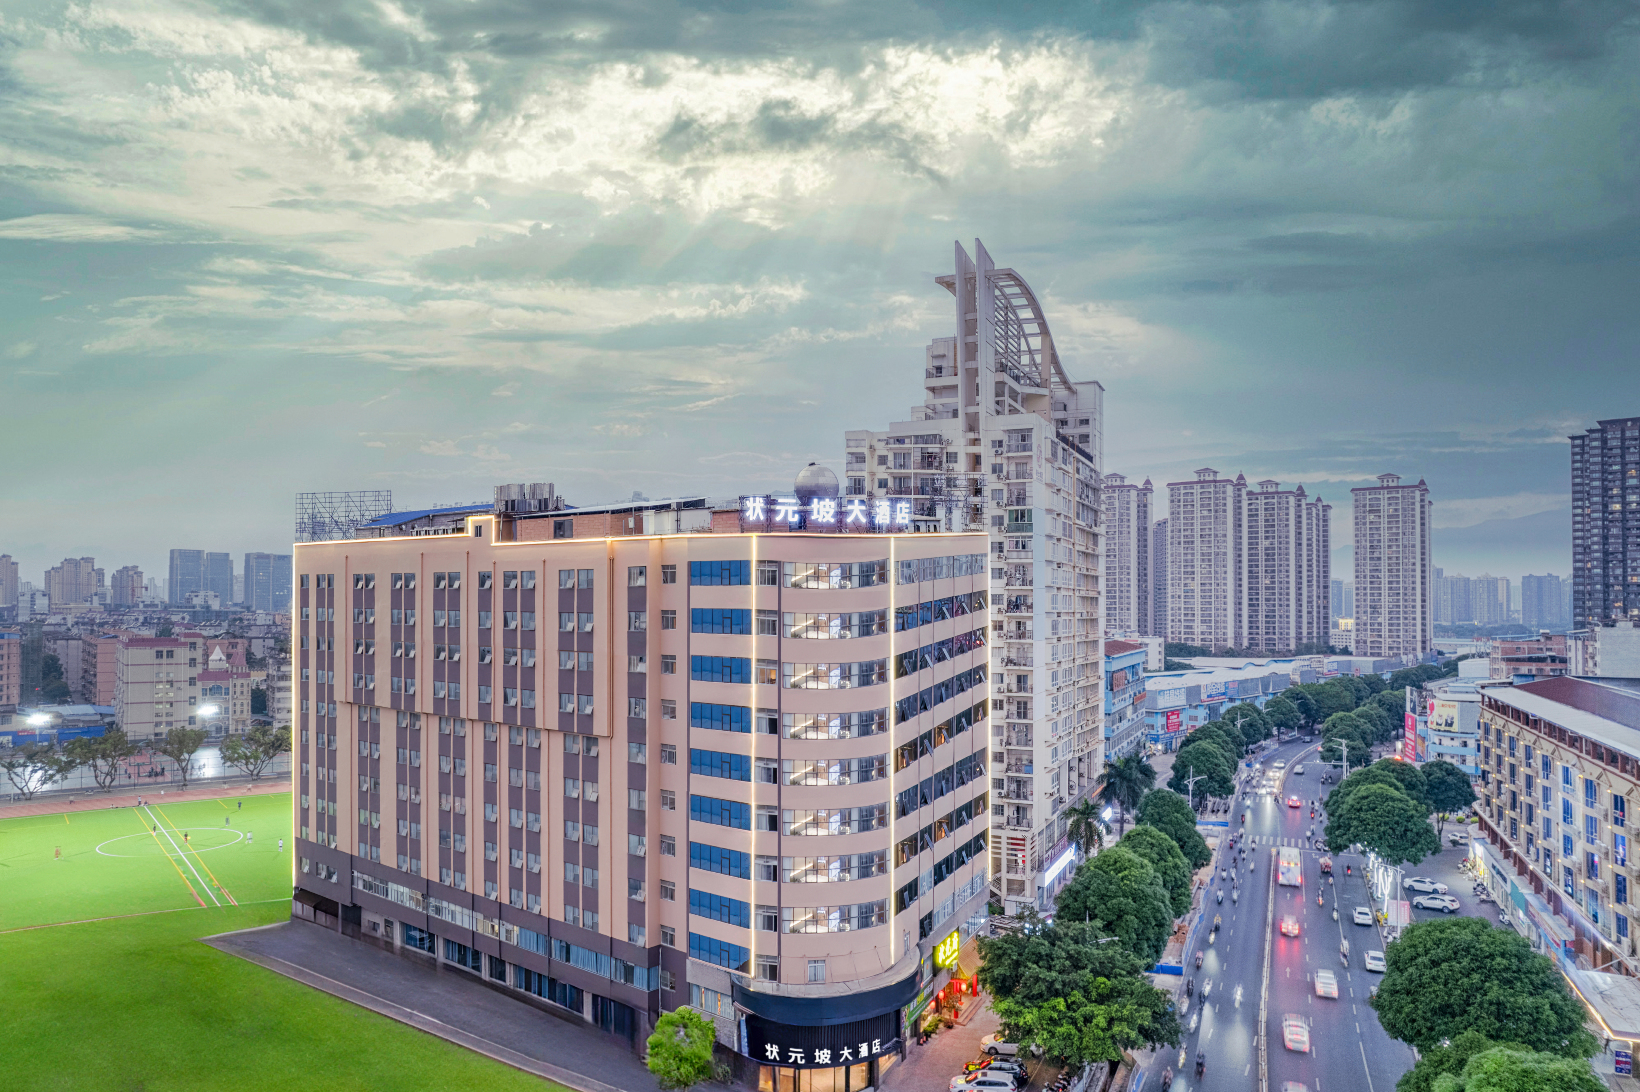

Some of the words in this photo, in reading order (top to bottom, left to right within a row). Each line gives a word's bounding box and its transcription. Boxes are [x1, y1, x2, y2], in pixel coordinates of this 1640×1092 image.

[746, 496, 910, 523] 状元坡大酒店
[765, 1039, 881, 1064] 状元坡大酒店
